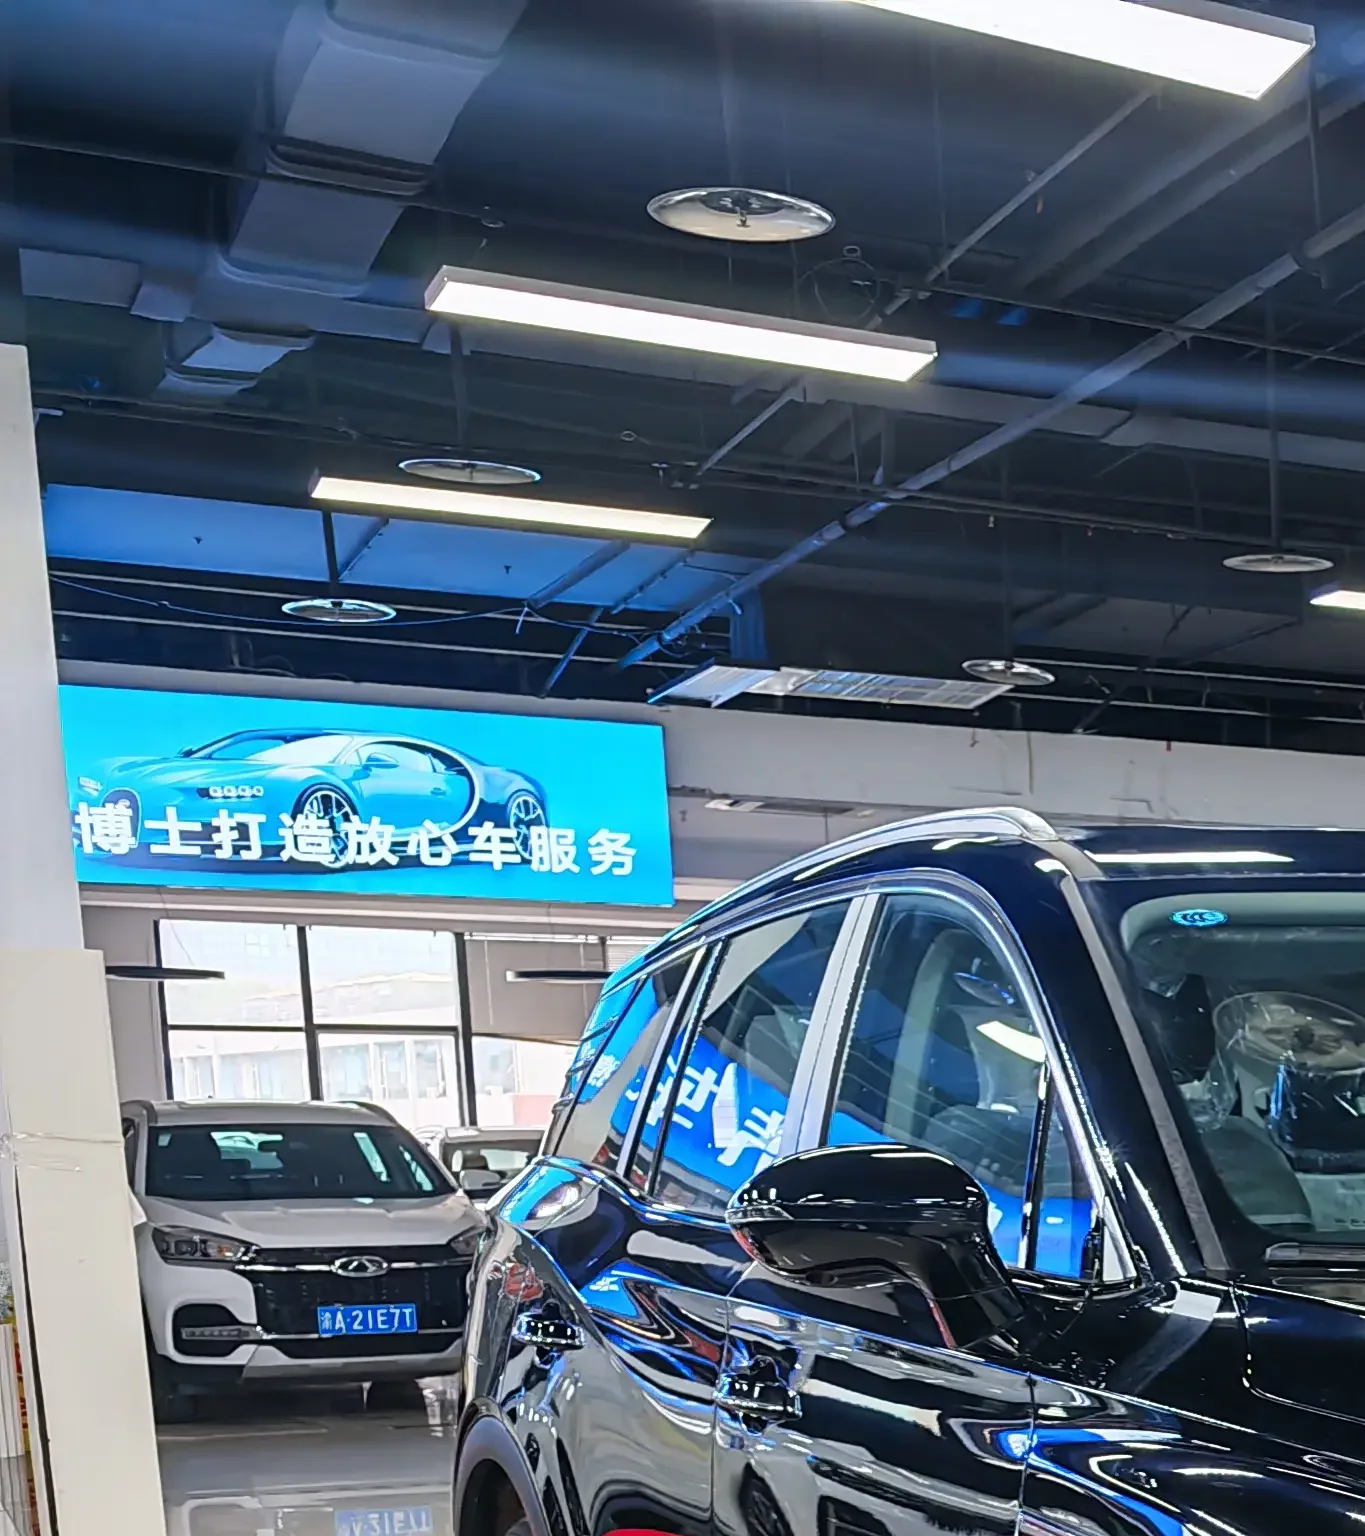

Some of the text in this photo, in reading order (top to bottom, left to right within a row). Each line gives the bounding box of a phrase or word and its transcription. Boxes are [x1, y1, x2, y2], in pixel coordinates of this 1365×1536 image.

[74, 801, 638, 877] 博士打造放心车服务
